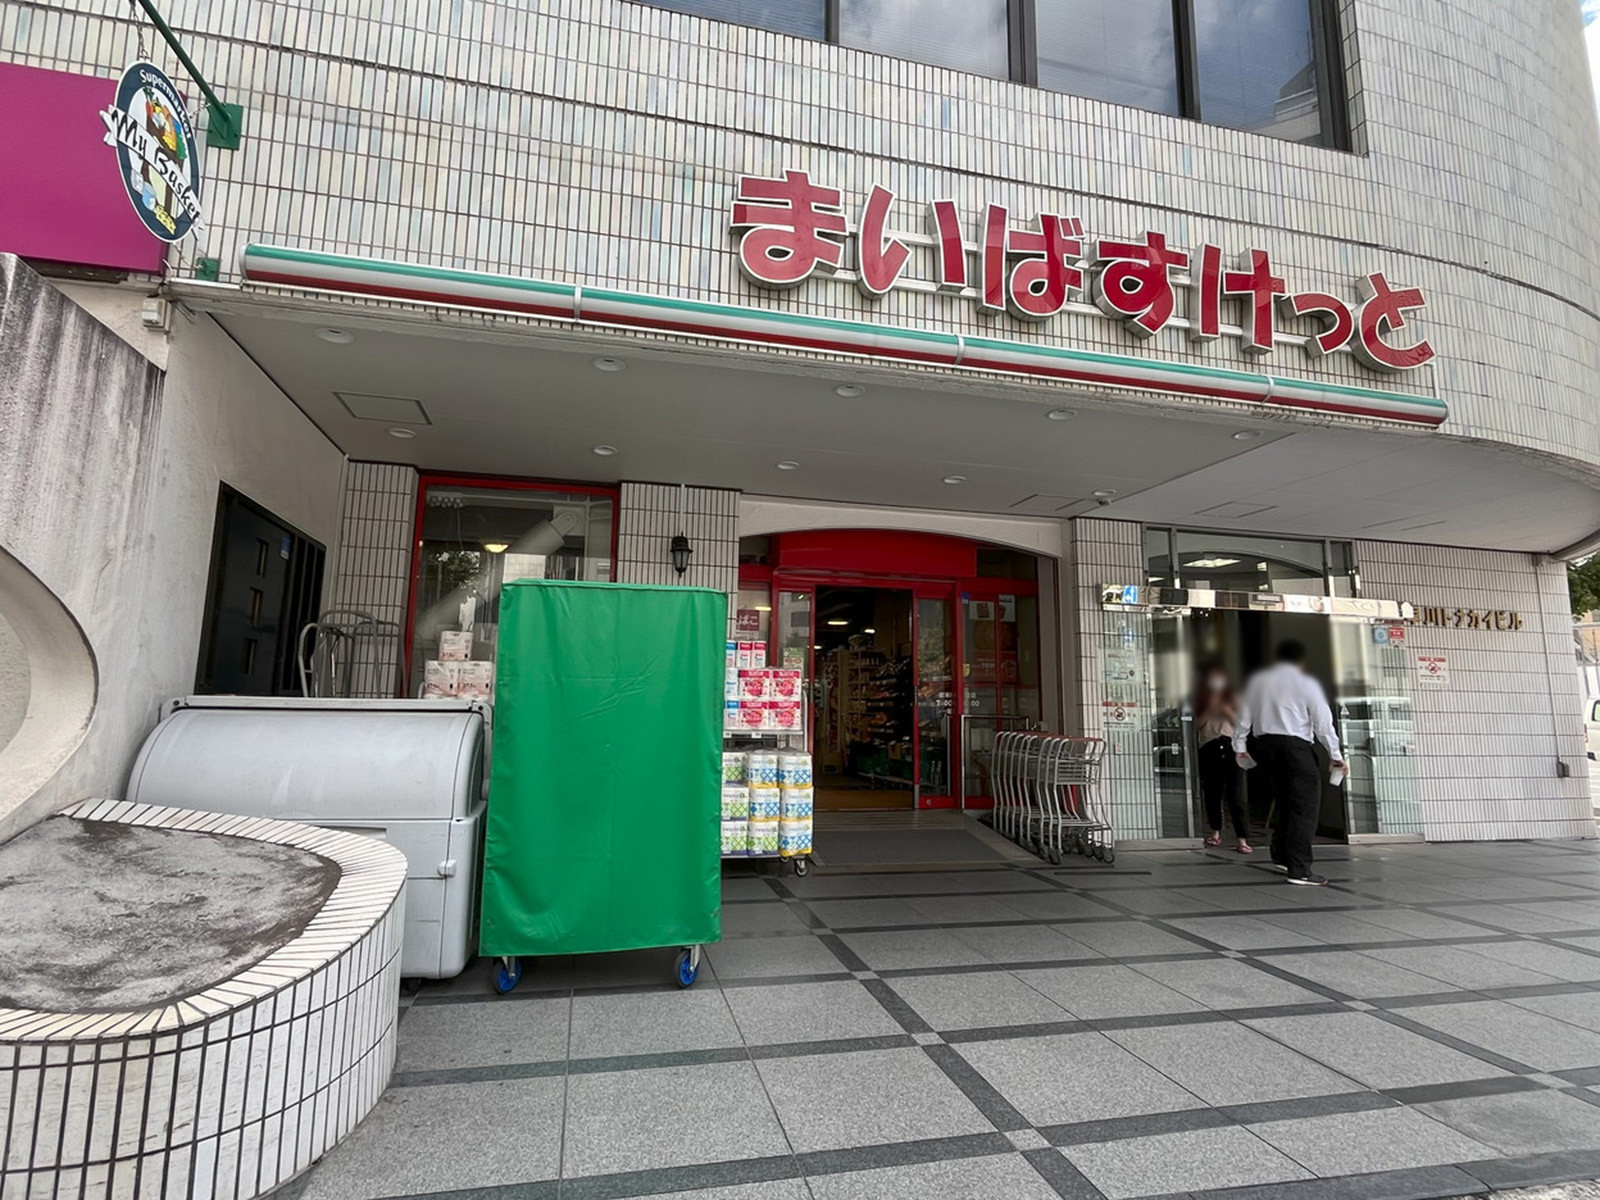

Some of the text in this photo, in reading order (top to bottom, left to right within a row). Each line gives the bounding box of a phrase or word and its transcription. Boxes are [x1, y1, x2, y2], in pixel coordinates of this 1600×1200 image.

[139, 69, 192, 139] Supermarket
[111, 109, 202, 222] My Basket
[731, 168, 1437, 371] まいばすけっと
